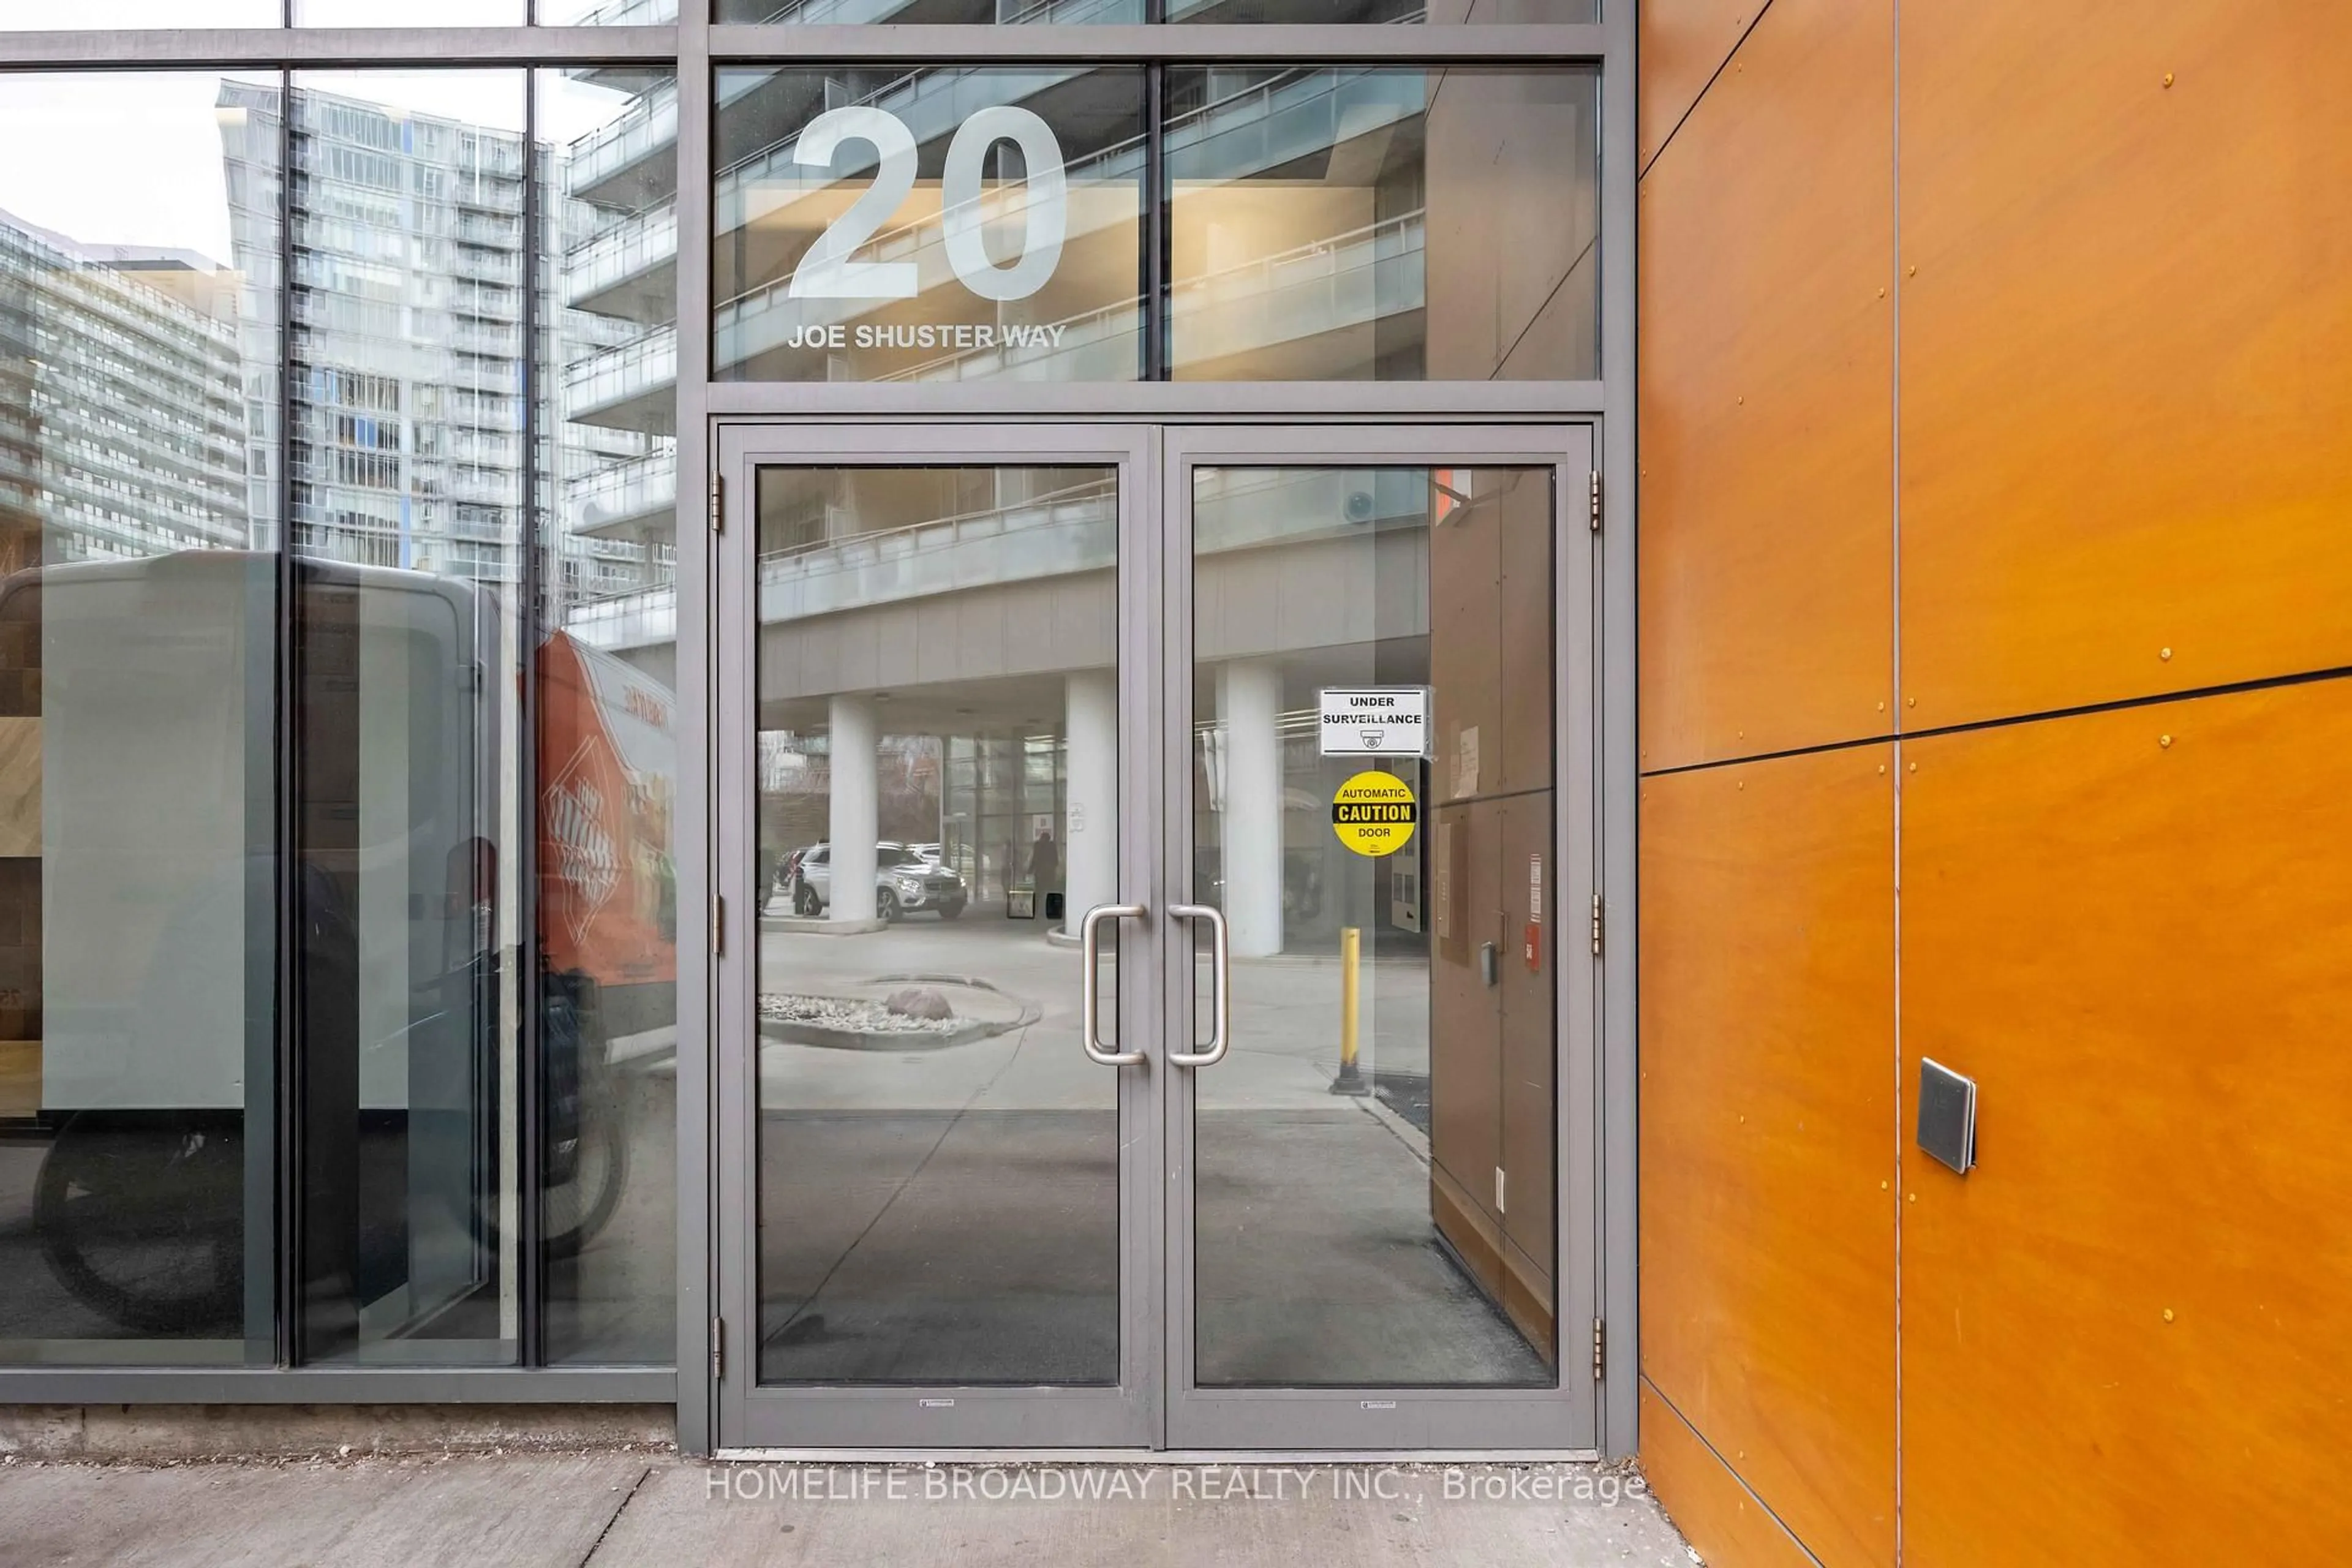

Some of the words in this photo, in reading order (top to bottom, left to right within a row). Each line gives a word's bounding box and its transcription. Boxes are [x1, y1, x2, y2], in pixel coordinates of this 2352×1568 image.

[789, 106, 1067, 301] 20
[788, 325, 845, 348] JOE
[855, 325, 994, 348] SHUSTER
[1003, 325, 1066, 348] WAY
[1350, 697, 1394, 707] UNDER
[1323, 714, 1422, 724] SURVEILLANCE
[1343, 788, 1406, 798] AUTOMATIC
[1338, 805, 1411, 821] CAUTION
[1359, 827, 1390, 837] DOOR
